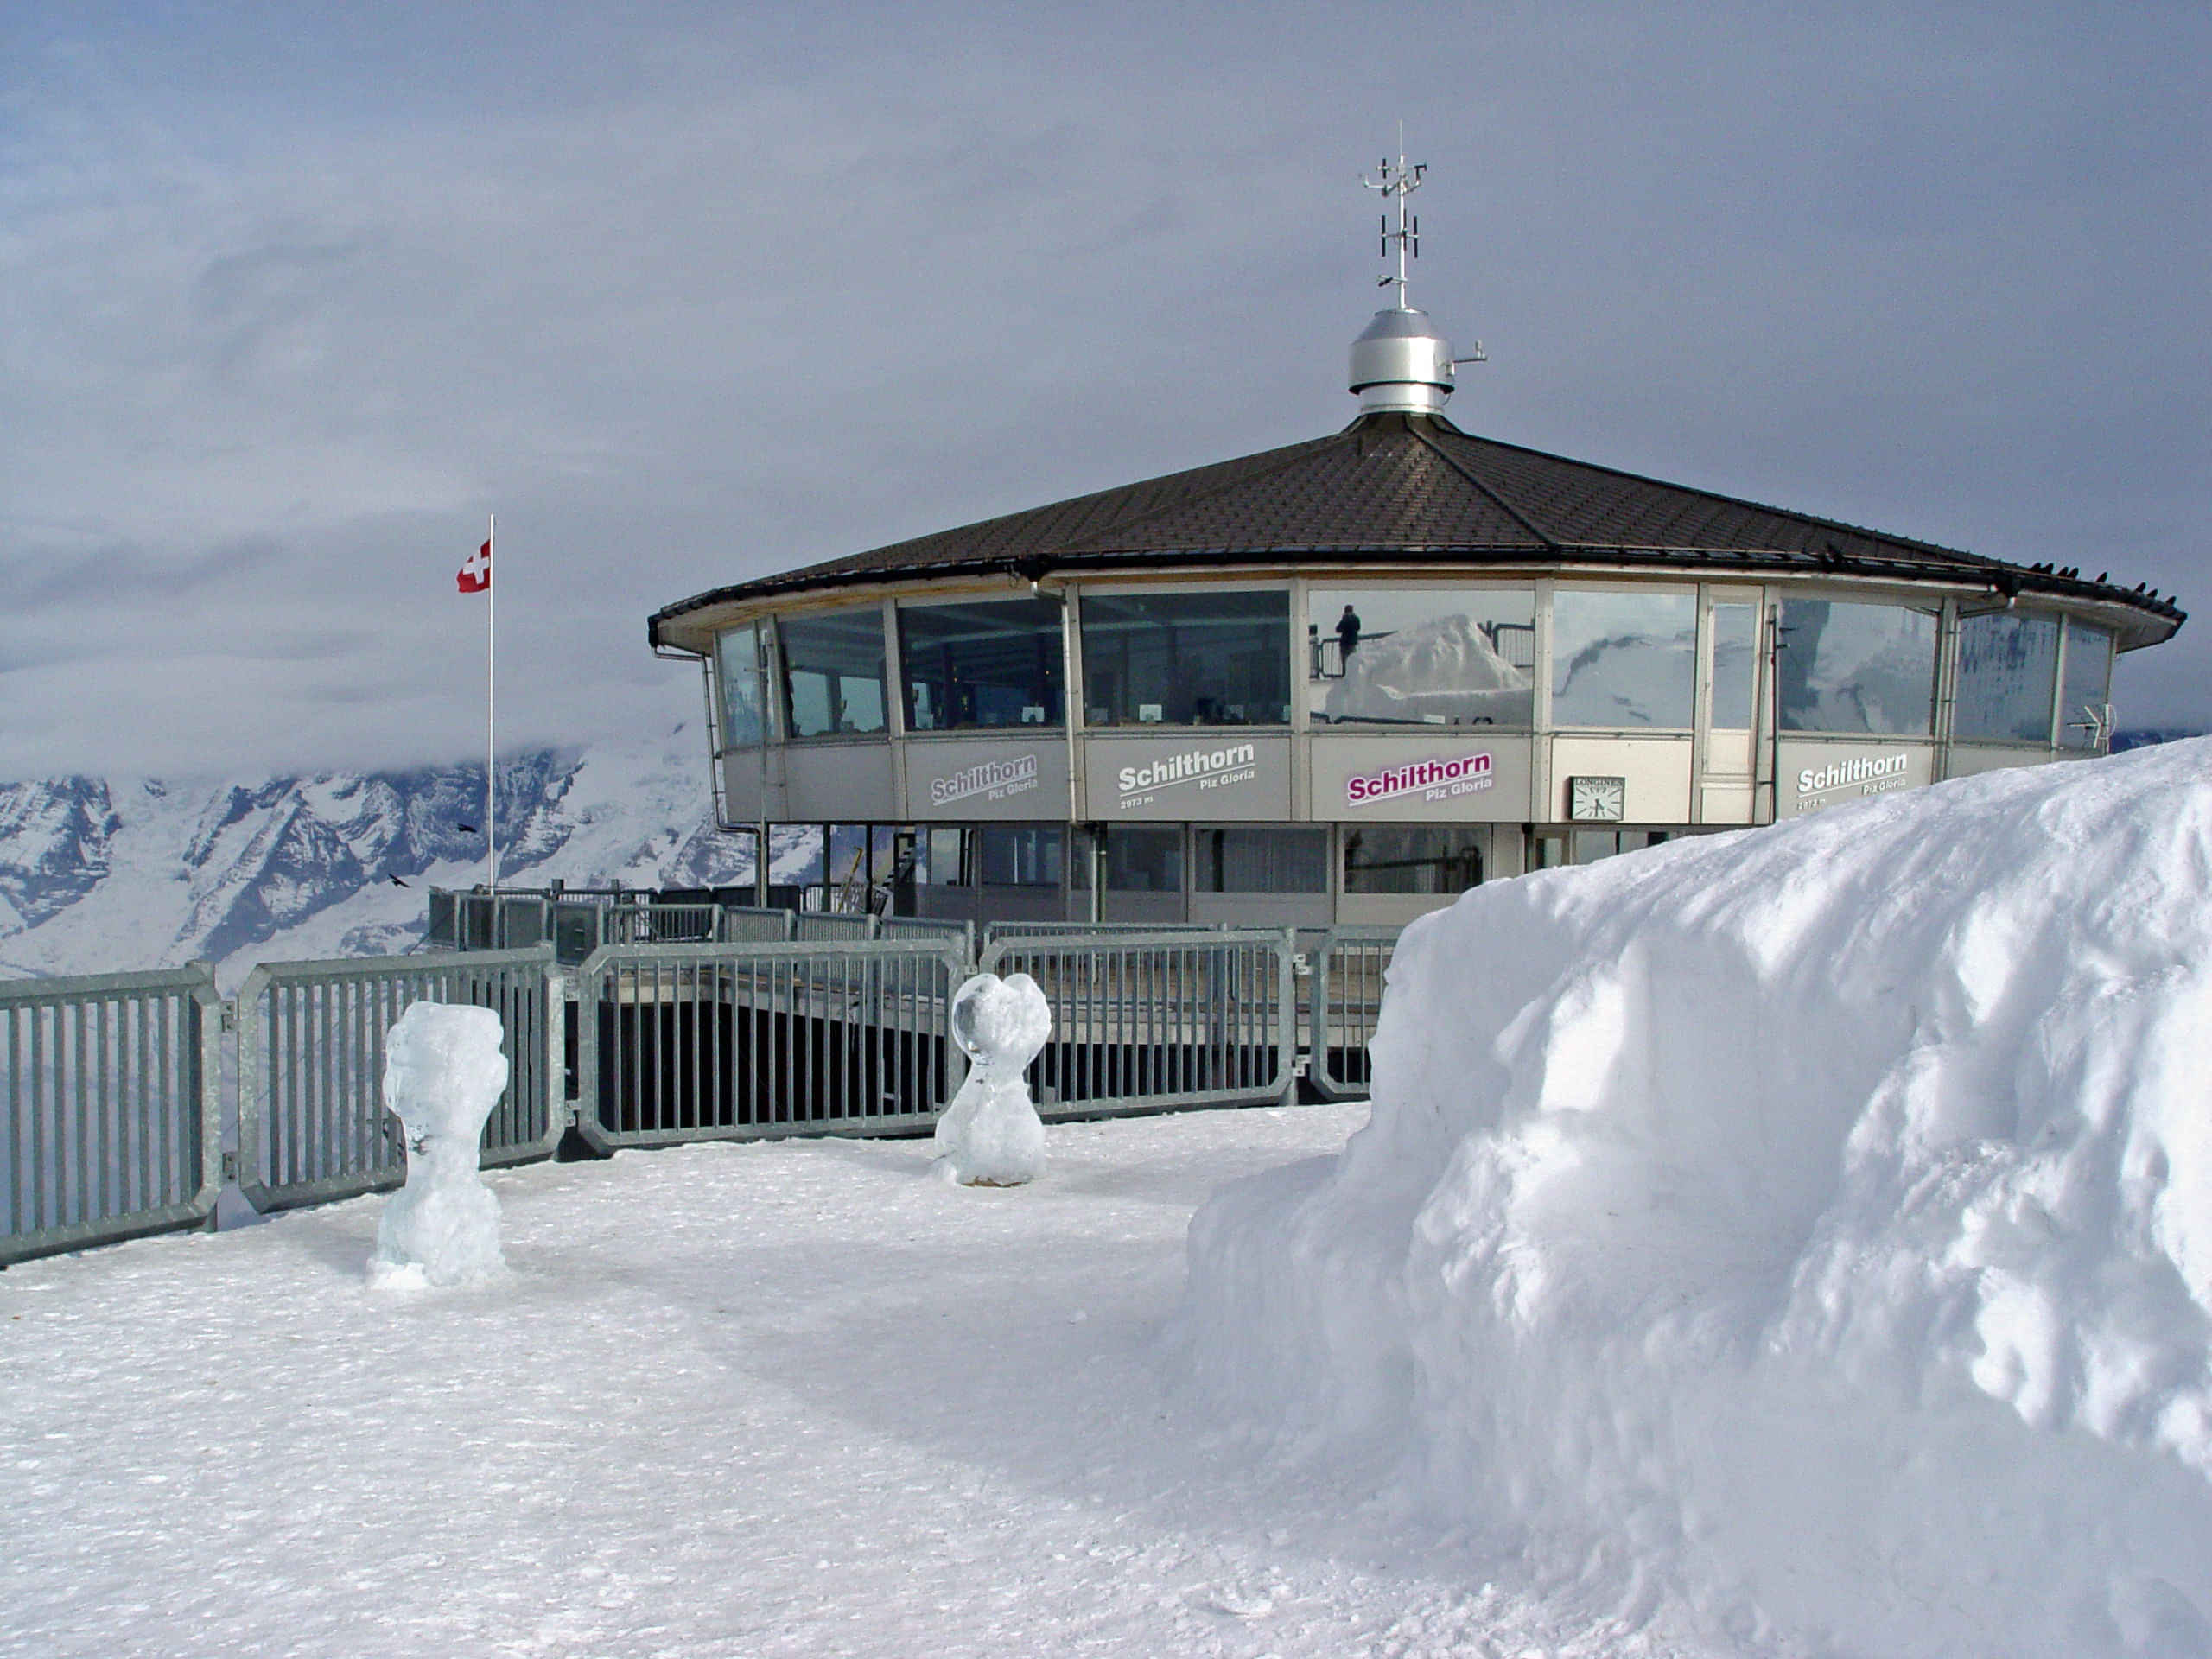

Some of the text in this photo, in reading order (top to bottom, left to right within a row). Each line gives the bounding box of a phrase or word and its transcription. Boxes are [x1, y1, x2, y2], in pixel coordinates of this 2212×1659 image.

[932, 754, 1037, 801] Schilthorn
[1118, 743, 1255, 791] Schilthorn
[1200, 770, 1255, 790] Piz Gloria
[1348, 753, 1491, 802] Schilthorn
[1797, 753, 1908, 793] Schilthorn
[988, 779, 1038, 801] Piz Gloria
[1426, 777, 1492, 802] Piz Gloria
